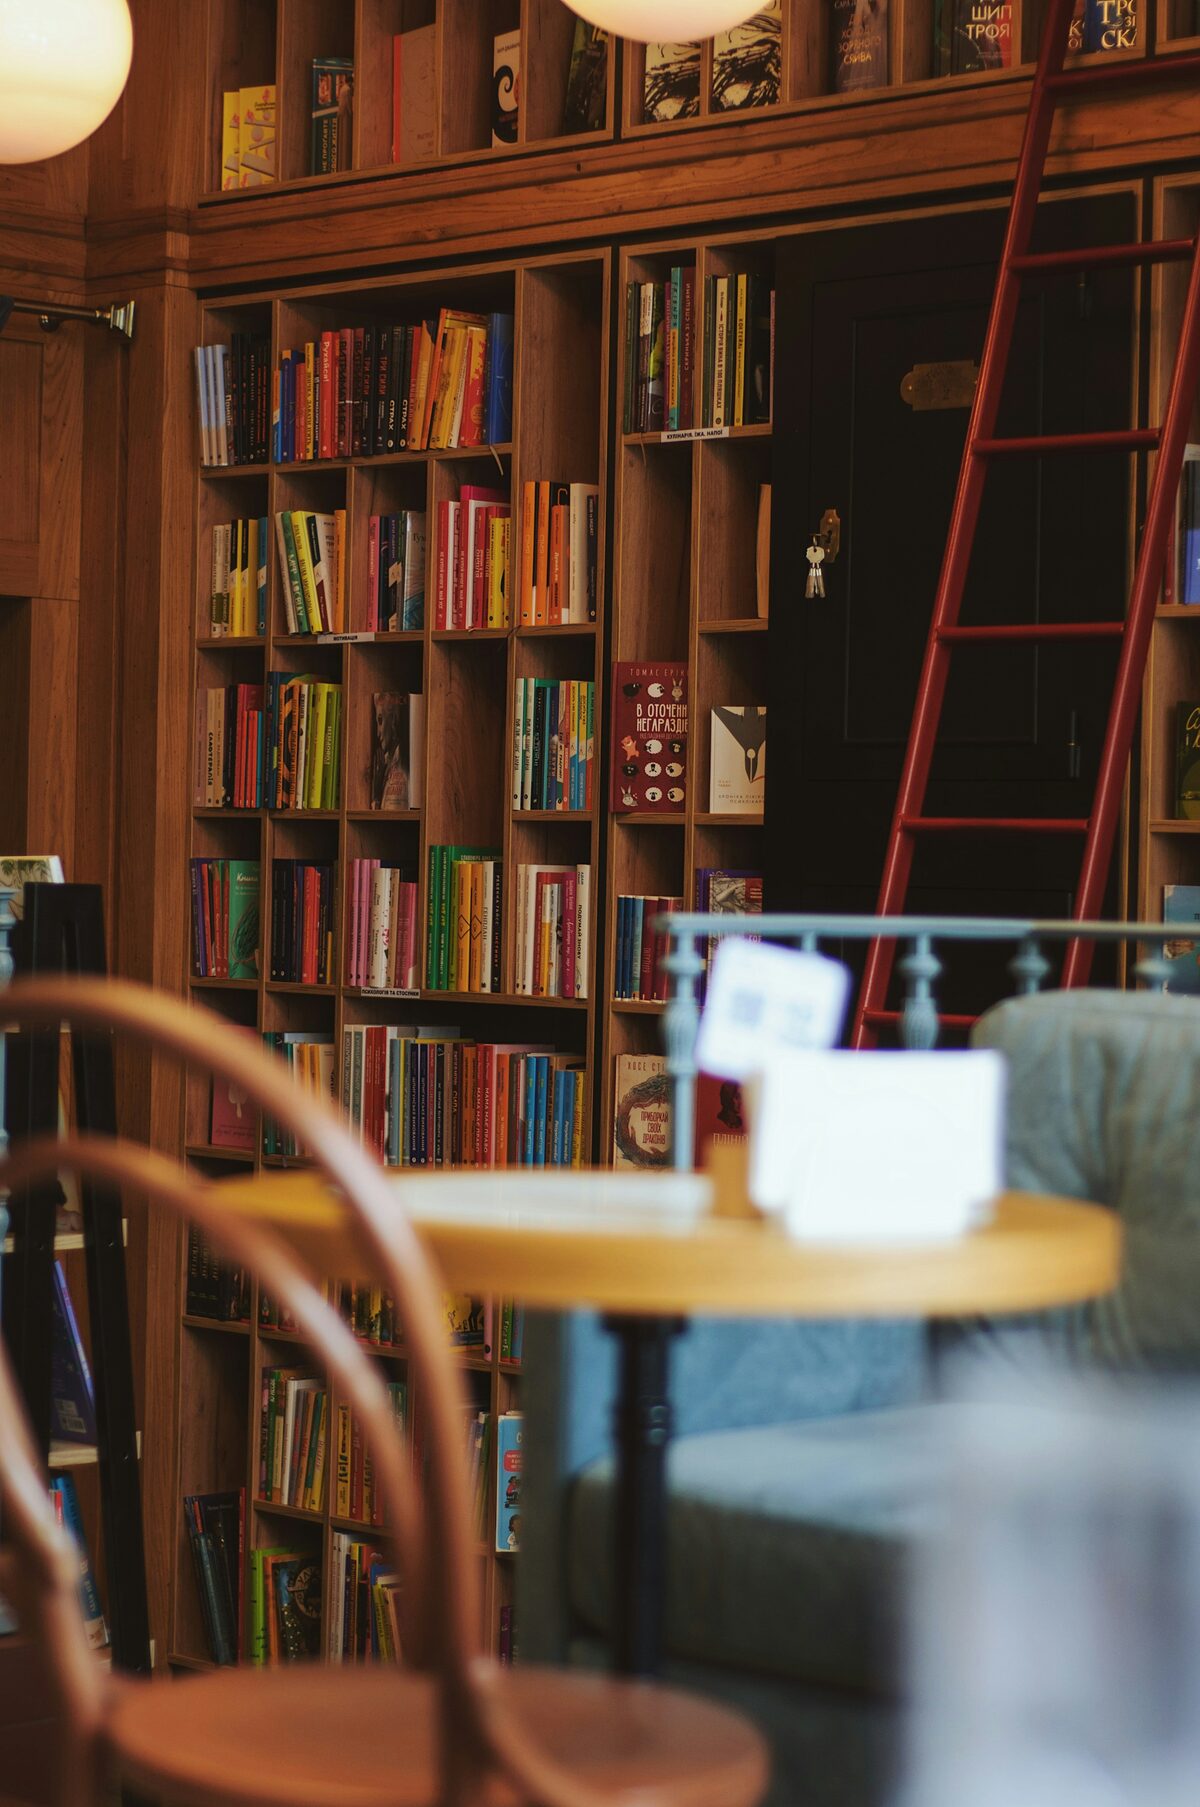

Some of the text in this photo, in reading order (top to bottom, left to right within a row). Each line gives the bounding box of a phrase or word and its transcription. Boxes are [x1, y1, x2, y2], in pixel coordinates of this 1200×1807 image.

[388, 399, 396, 431] СТРАХ
[400, 399, 408, 430] СТРАХ
[629, 668, 660, 677] ТОМАС
[636, 703, 643, 718] В
[627, 1061, 647, 1072] ХОСЕ
[640, 1110, 669, 1124] ПРИБОРКАЙ
[647, 1122, 662, 1134] СВОЇХ
[642, 1133, 666, 1145] ДРАКОНІВ
